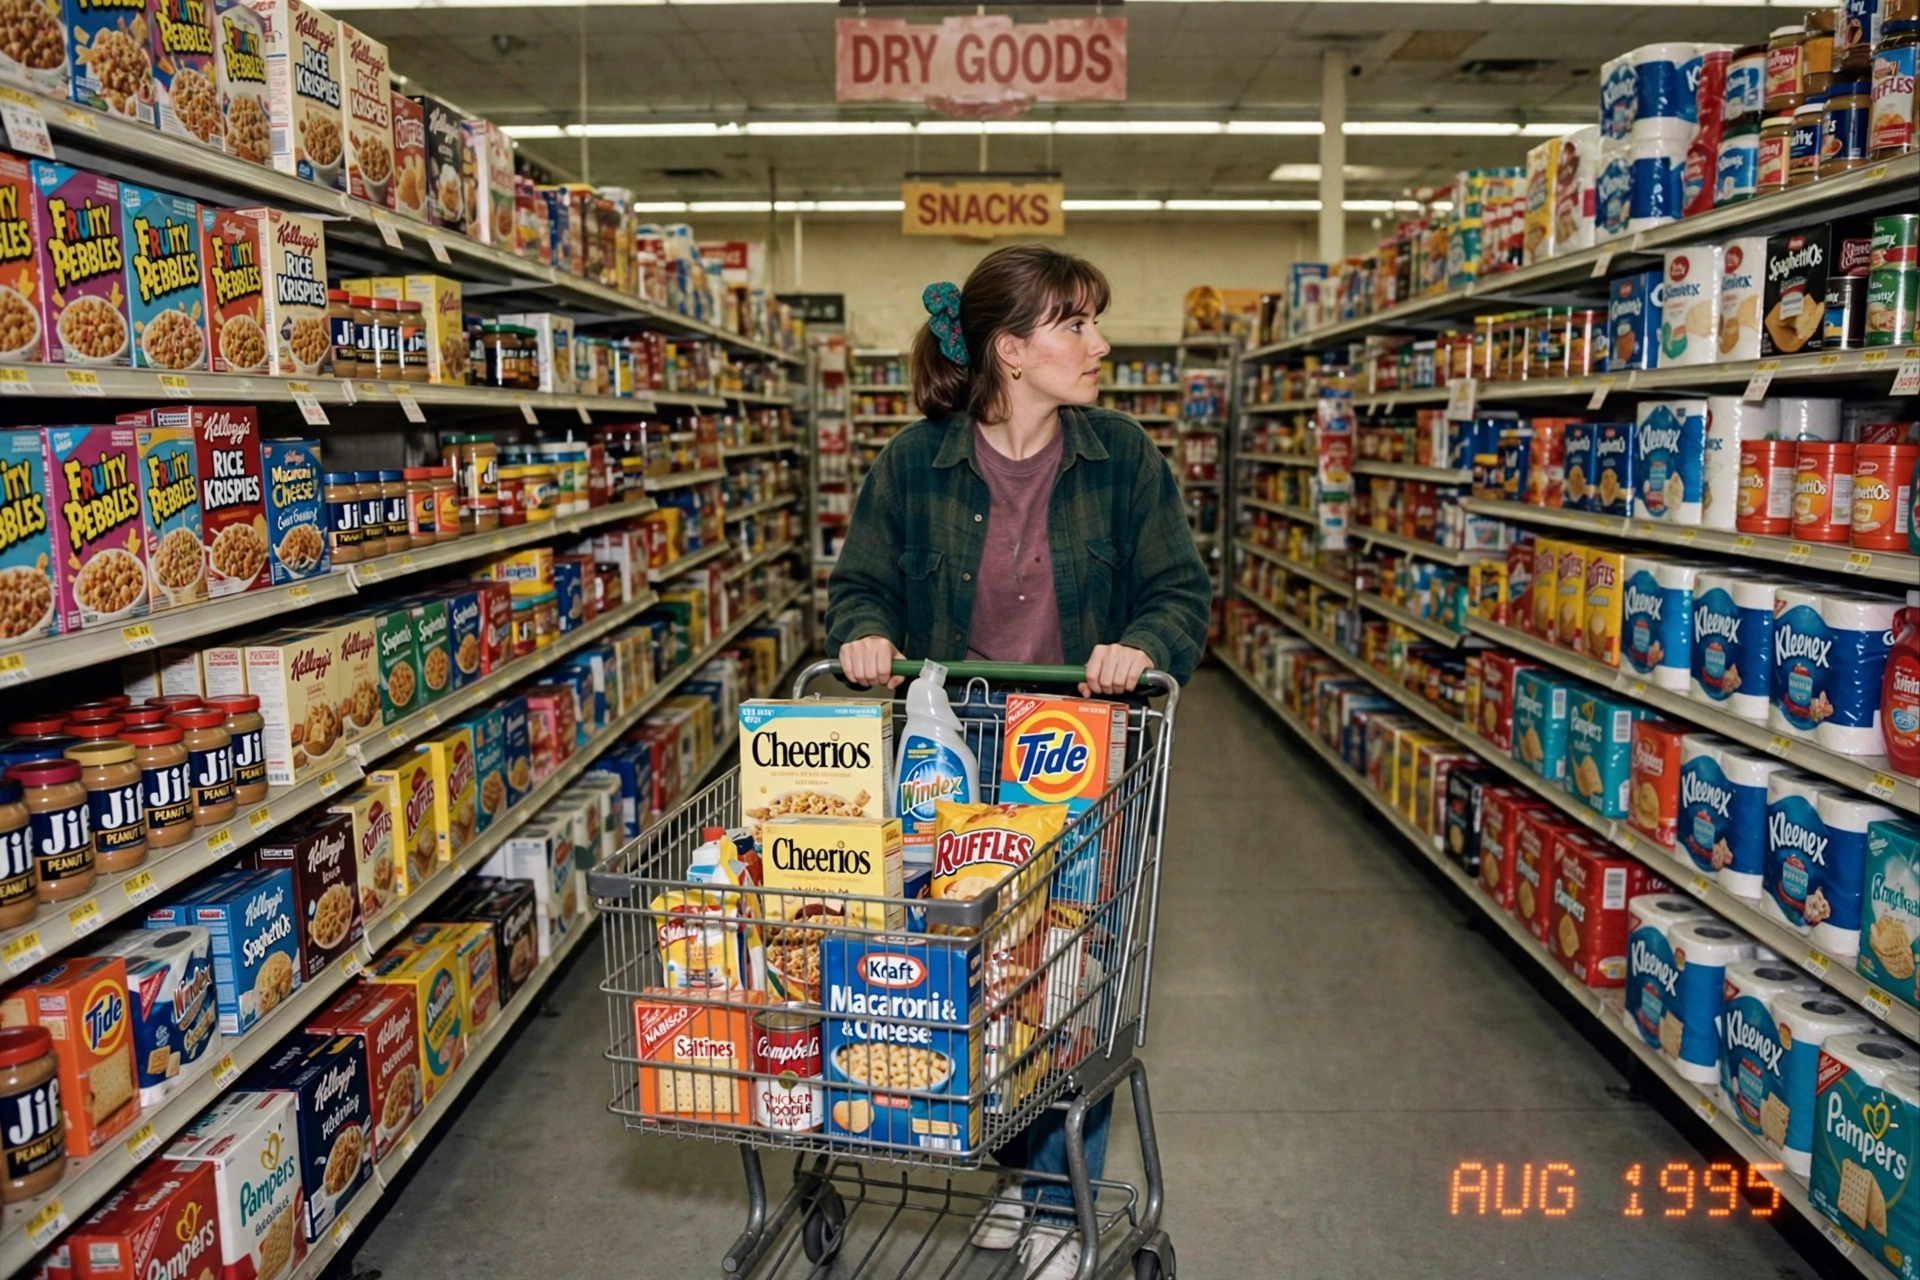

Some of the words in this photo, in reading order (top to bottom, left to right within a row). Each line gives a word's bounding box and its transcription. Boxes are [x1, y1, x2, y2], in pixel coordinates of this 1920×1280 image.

[157, 19, 214, 55] PEBBLES
[303, 42, 329, 73] RICE
[225, 44, 267, 84] PEBBLES
[852, 34, 938, 84] DRY
[955, 33, 1113, 84] GOODS
[294, 62, 341, 109] KRISPIES
[356, 69, 379, 101] RICE
[917, 193, 1050, 227] SNACKS
[277, 221, 320, 256] Kellogg's
[47, 235, 123, 288] PEBBLES
[133, 251, 201, 304] PEBBLES
[284, 252, 314, 280] RICE
[211, 265, 262, 306] PEBBLES
[276, 273, 327, 307] KRISPIES
[203, 412, 250, 445] Kellogg's
[212, 449, 245, 478] RICE
[148, 475, 198, 524] PEBBLES
[204, 473, 260, 512] KRISPIES
[271, 481, 315, 509] Cheese
[63, 482, 141, 552] PEBBLES
[1624, 586, 1662, 621] Kleenex
[1694, 609, 1740, 644] Kleenex
[1774, 624, 1832, 668] Kleenex
[291, 648, 332, 681] Kellogg's
[752, 731, 872, 770] Cheerios
[1016, 730, 1089, 785] Tide
[150, 763, 190, 807] Jif
[900, 772, 964, 816] Windex
[1682, 771, 1731, 818] Kleenex
[101, 783, 144, 830] Jif
[155, 807, 185, 822] PEANUT
[42, 804, 90, 856] Jif
[107, 827, 138, 845] PEANUT
[1769, 812, 1828, 866] Kleenex
[48, 856, 83, 873] PEANUT
[308, 832, 345, 873] Kellogg's
[772, 837, 871, 875] Cheerios
[932, 827, 1035, 881] RUFFLES
[245, 886, 284, 927] Kellogg's
[869, 961, 914, 981] Kraft
[1631, 940, 1680, 997] Kleenex
[85, 992, 123, 1050] Tide
[830, 985, 939, 1020] Macaroni
[941, 999, 957, 1021] &
[644, 1007, 688, 1048] NABISCO
[677, 1038, 734, 1058] Saltines
[1726, 1006, 1783, 1077] Kleenex
[314, 1057, 357, 1112] Kellogg's
[9, 1078, 59, 1145] Jif
[1827, 1091, 1908, 1181] Pampers
[240, 1156, 295, 1228] Pampers
[147, 1219, 215, 1280] Pampers
